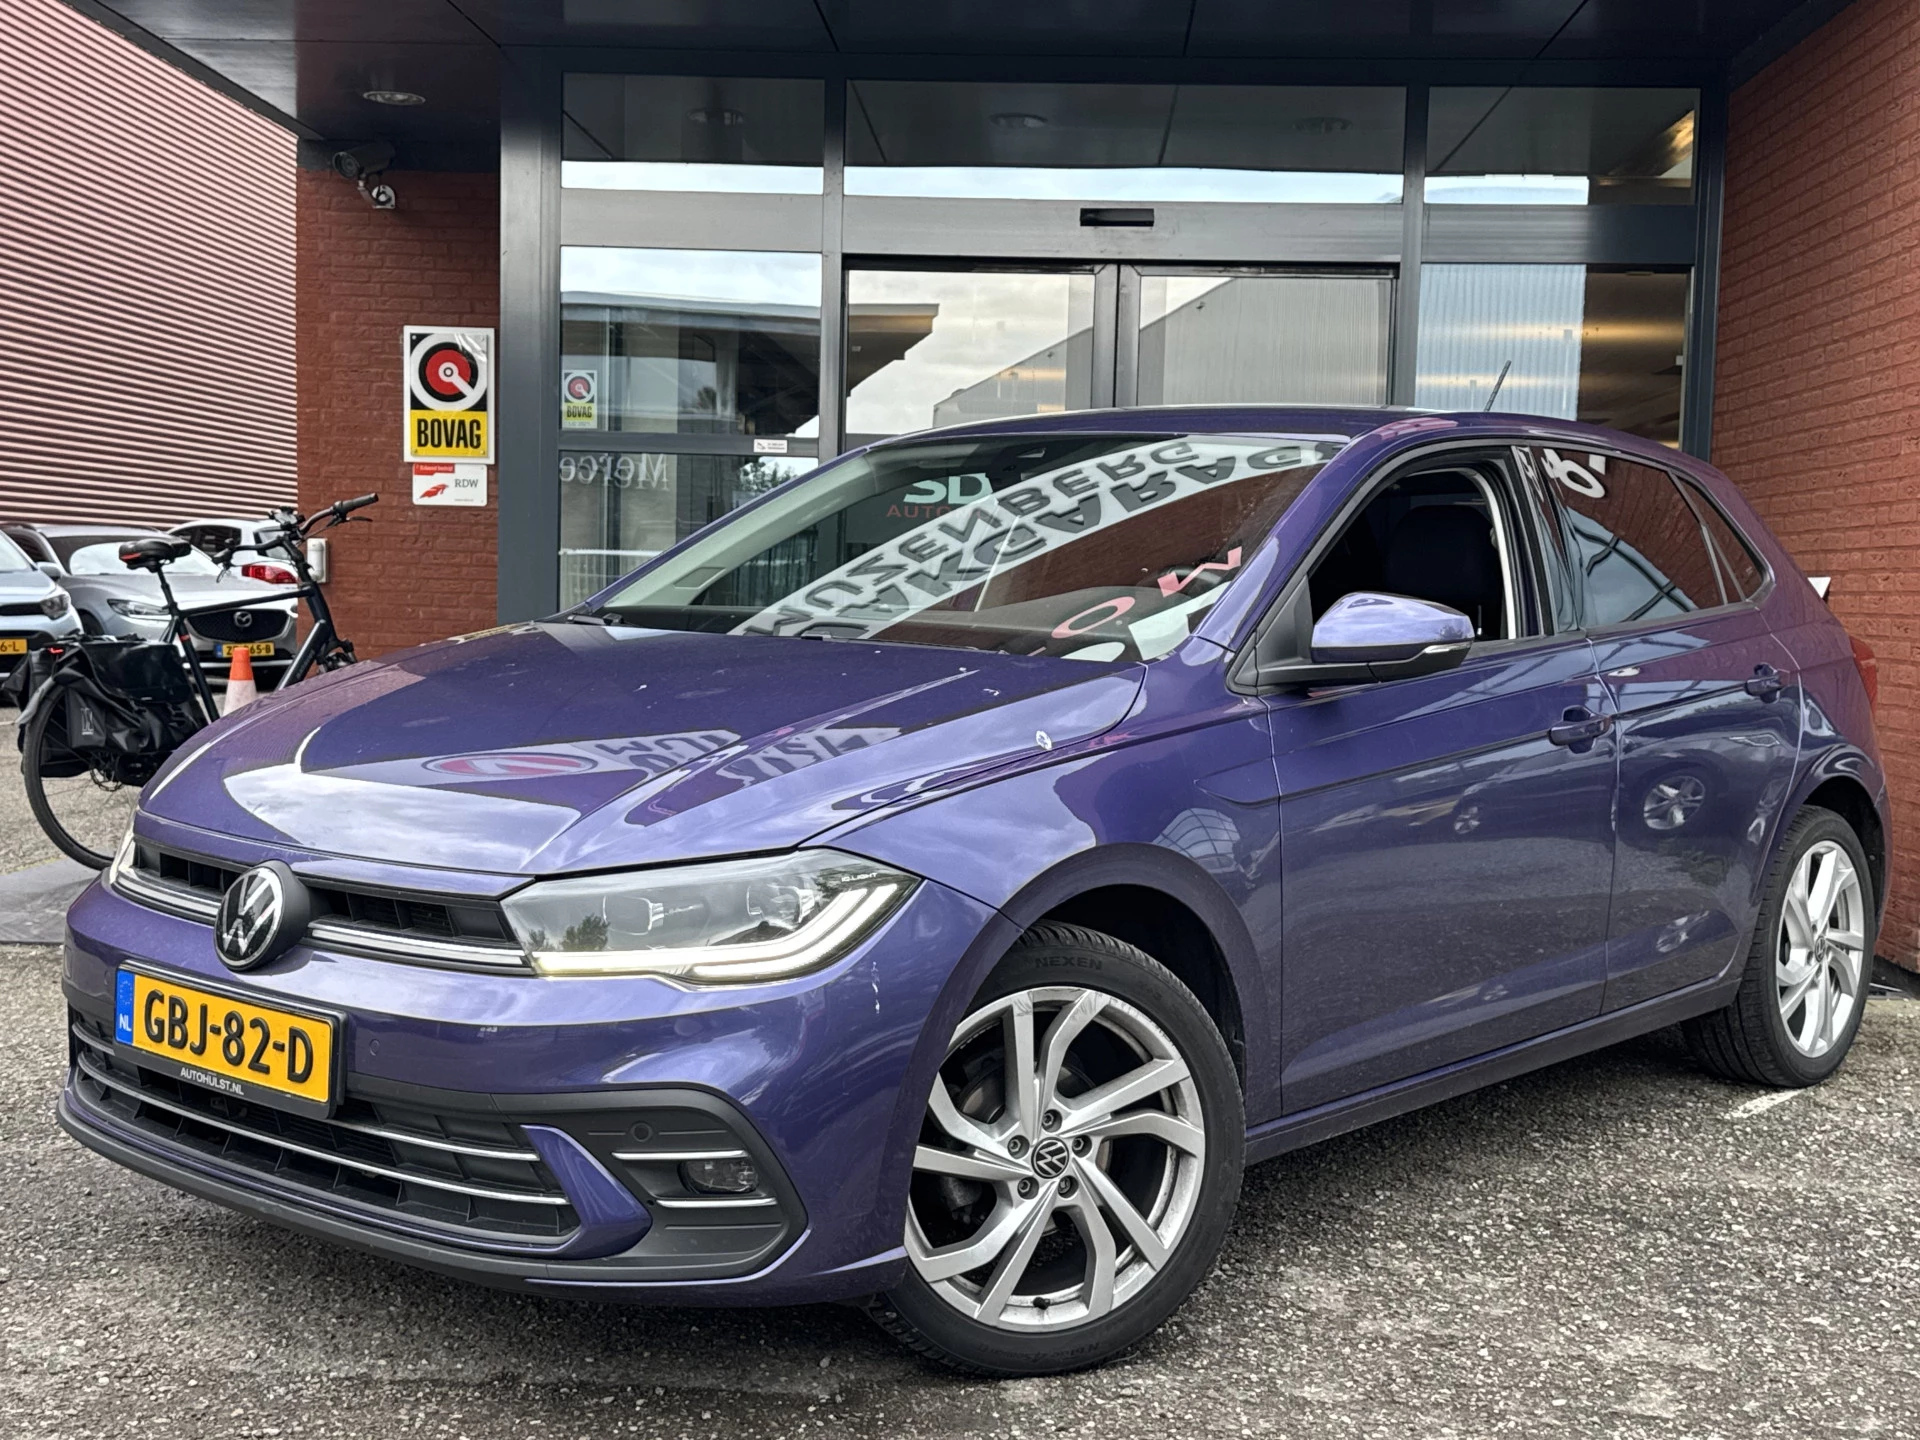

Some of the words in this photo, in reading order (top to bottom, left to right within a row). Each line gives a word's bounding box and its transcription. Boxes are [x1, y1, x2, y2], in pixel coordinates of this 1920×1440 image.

[566, 405, 593, 418] BOVAG
[417, 418, 481, 449] BOVAG
[454, 479, 479, 488] RDW
[904, 473, 993, 504] SD
[1035, 955, 1102, 970] NEXEN
[119, 1013, 132, 1032] NL
[144, 989, 313, 1083] GBJ-82-D
[180, 1067, 244, 1096] AUTOHULST.NL
